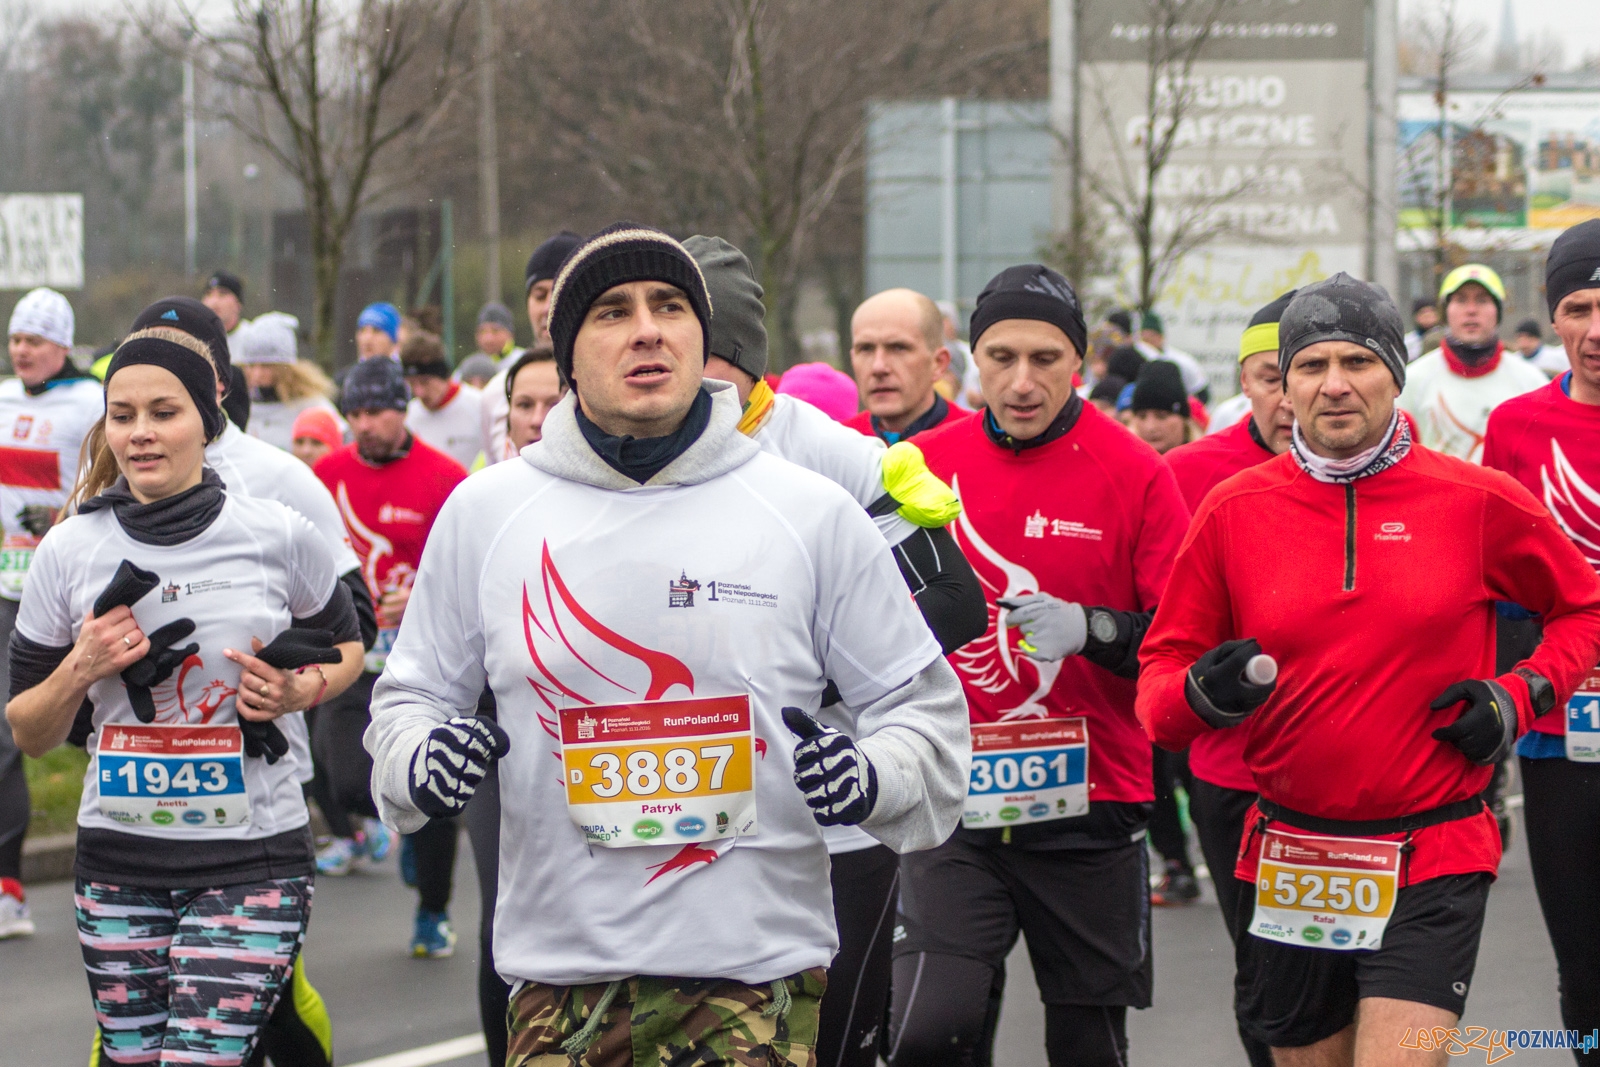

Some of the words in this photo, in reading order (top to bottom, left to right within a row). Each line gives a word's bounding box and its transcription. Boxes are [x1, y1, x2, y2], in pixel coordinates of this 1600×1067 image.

[707, 580, 719, 601] 1
[718, 582, 751, 590] Poznański
[718, 588, 733, 596] Bieg
[734, 590, 778, 600] Niepodległości
[722, 596, 747, 605] Poznań,
[748, 598, 777, 608] 11.11.2016
[663, 713, 739, 727] RunPoland.org
[1570, 708, 1579, 719] E
[601, 717, 610, 733] 1
[172, 738, 232, 747] RunPoland.org
[102, 770, 111, 782] E
[118, 760, 229, 795] 1943
[570, 769, 584, 785] D
[589, 744, 734, 798] 3887
[970, 753, 1068, 792] 3061
[641, 803, 682, 815] Patryk
[1327, 852, 1388, 864] RunPoland.org
[1260, 879, 1269, 891] D
[1273, 870, 1380, 913] 5250
